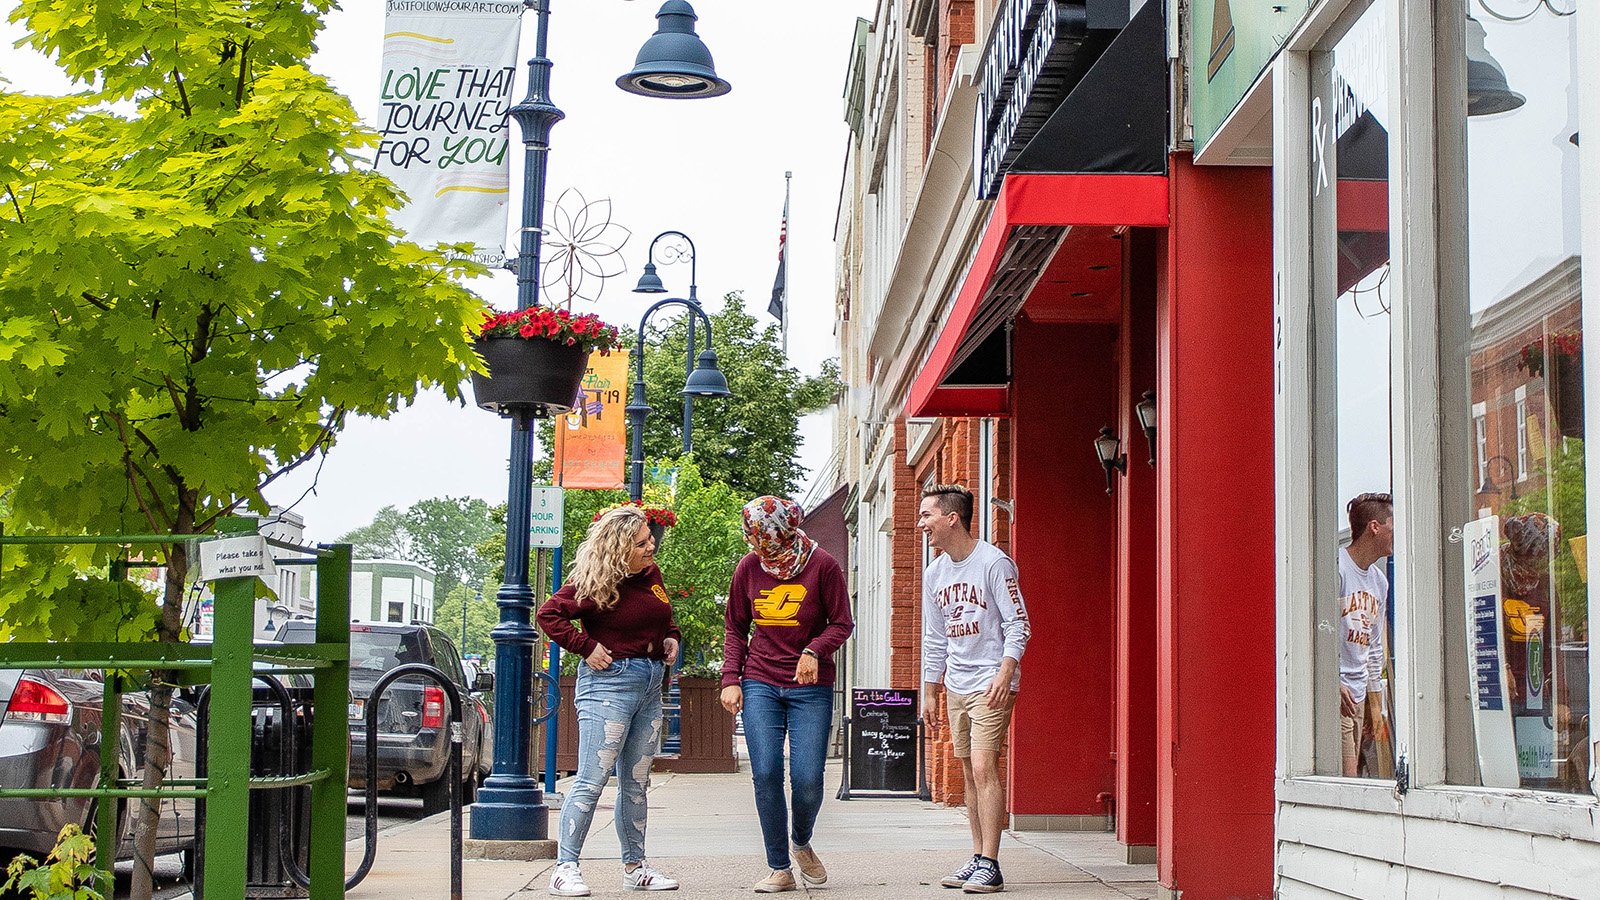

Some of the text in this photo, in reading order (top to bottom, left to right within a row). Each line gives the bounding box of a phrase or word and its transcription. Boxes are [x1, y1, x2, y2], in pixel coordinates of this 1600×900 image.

[387, 0, 519, 15] JUSTFOLLOWYOURART.COM
[381, 66, 516, 101] LOVE THAT
[377, 100, 509, 136] JOURNEY
[373, 135, 509, 169] FOR YOU
[540, 498, 546, 507] 3
[531, 512, 554, 521] HOUR
[529, 525, 560, 535] ARKING
[216, 551, 240, 561] Please
[242, 549, 258, 558] take
[218, 564, 236, 573] what
[238, 564, 252, 574] you
[854, 690, 869, 701] In
[883, 691, 912, 705] Gallery
